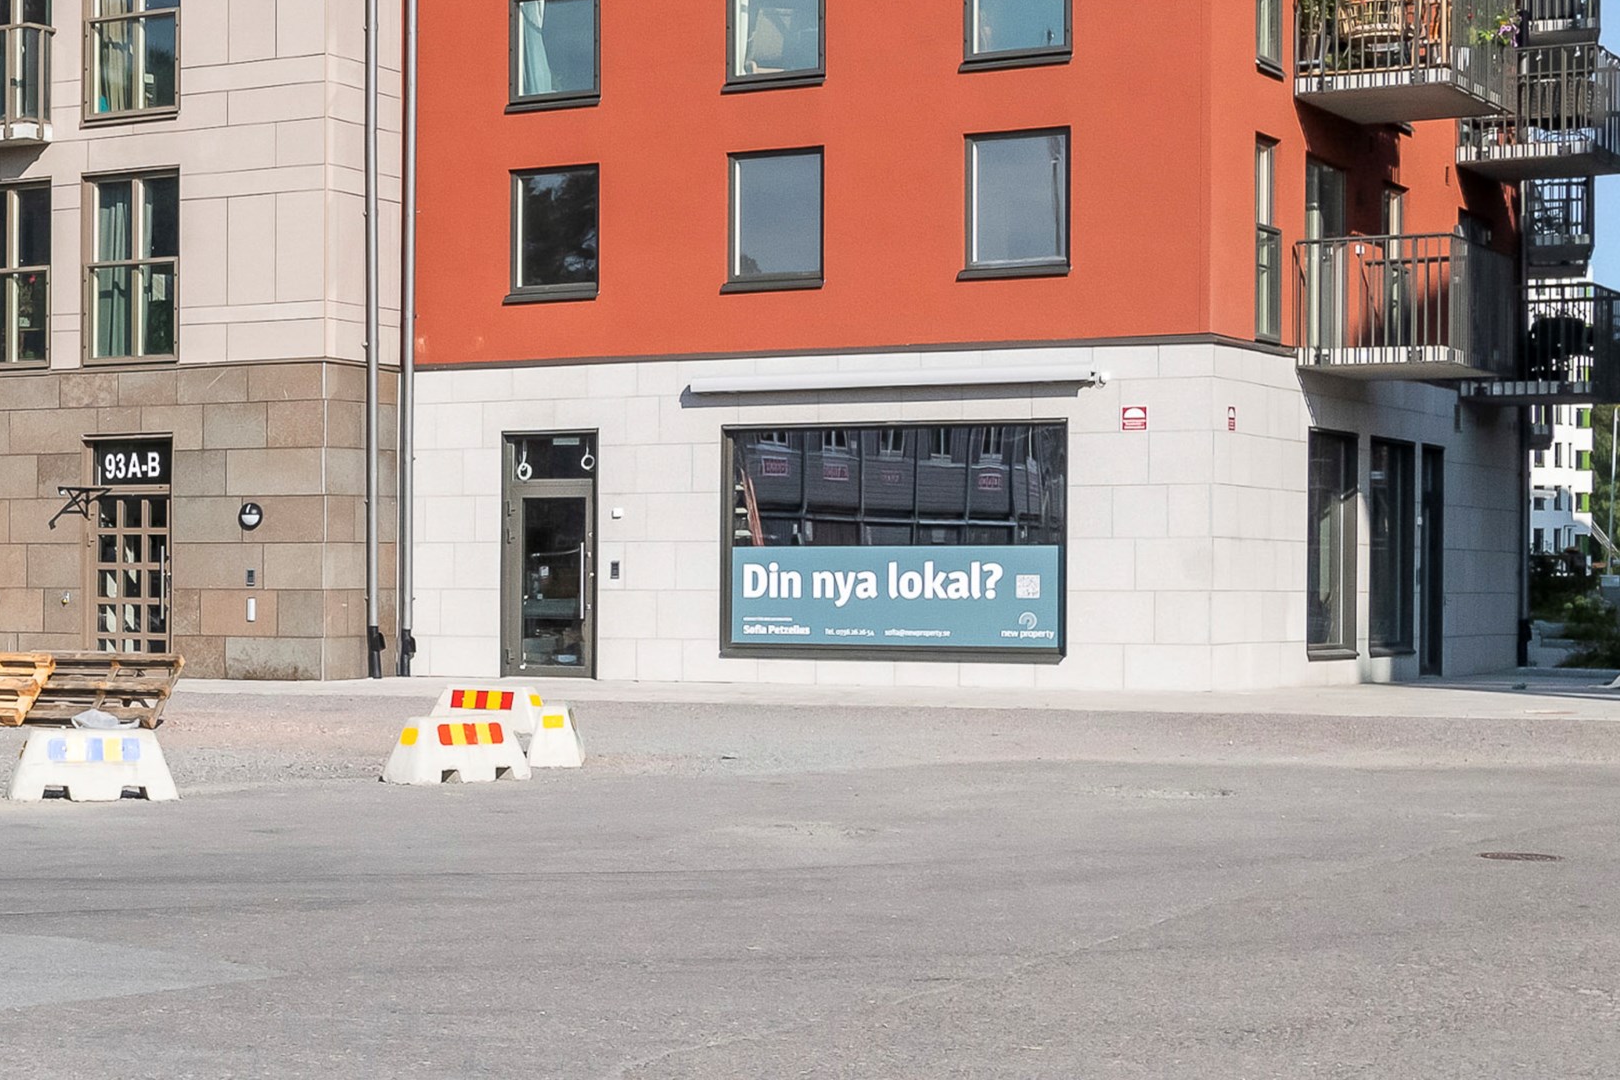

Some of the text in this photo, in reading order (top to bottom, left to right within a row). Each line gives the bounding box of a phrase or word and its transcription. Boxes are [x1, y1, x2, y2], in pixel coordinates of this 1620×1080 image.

[742, 560, 1004, 608] Din nya lokal?
[743, 624, 767, 635] Sofia
[1019, 630, 1055, 639] property
